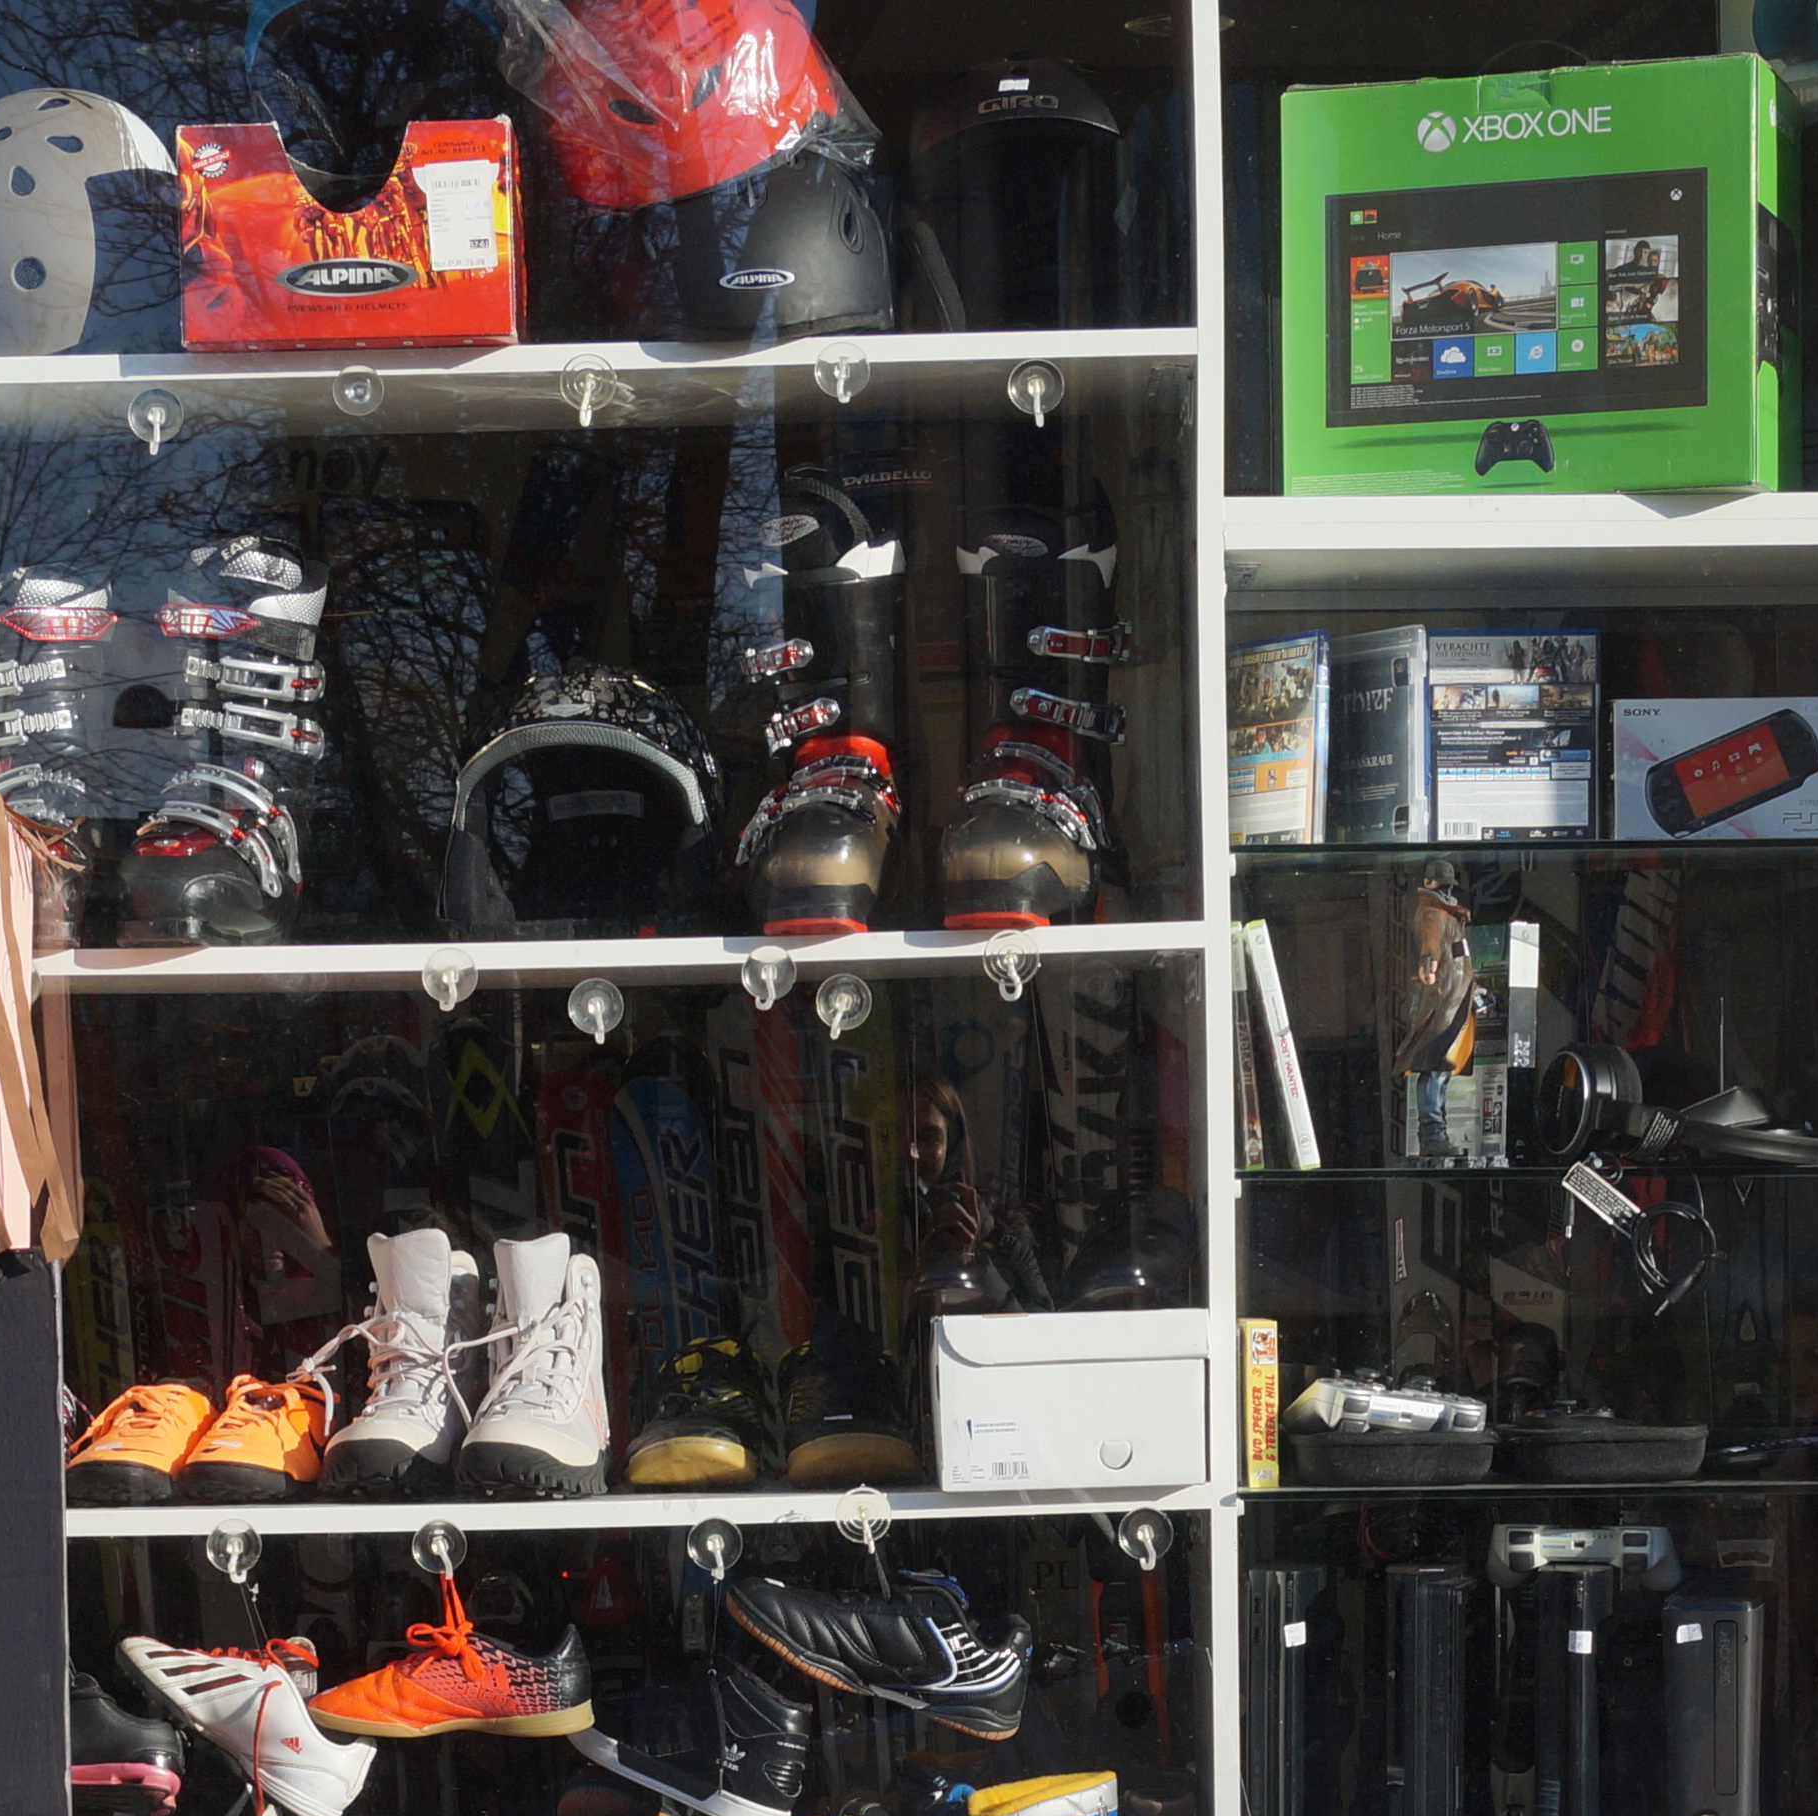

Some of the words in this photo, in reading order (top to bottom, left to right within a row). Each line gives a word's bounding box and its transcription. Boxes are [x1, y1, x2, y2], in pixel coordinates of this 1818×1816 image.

[978, 95, 1059, 115] GIRO
[1462, 110, 1543, 144] XBOX
[1547, 105, 1612, 136] ONE
[293, 266, 398, 287] ALPINA
[730, 274, 785, 287] ALPINA
[356, 301, 409, 311] HELMETS
[842, 470, 933, 487] DALBELLO
[1435, 642, 1491, 652] VERACHTE
[1623, 708, 1661, 716] SONY
[1264, 1374, 1276, 1399] HILL
[1251, 1387, 1263, 1435] SPENCER
[1264, 1401, 1276, 1450] TERENCE
[1252, 1438, 1263, 1461] BUD
